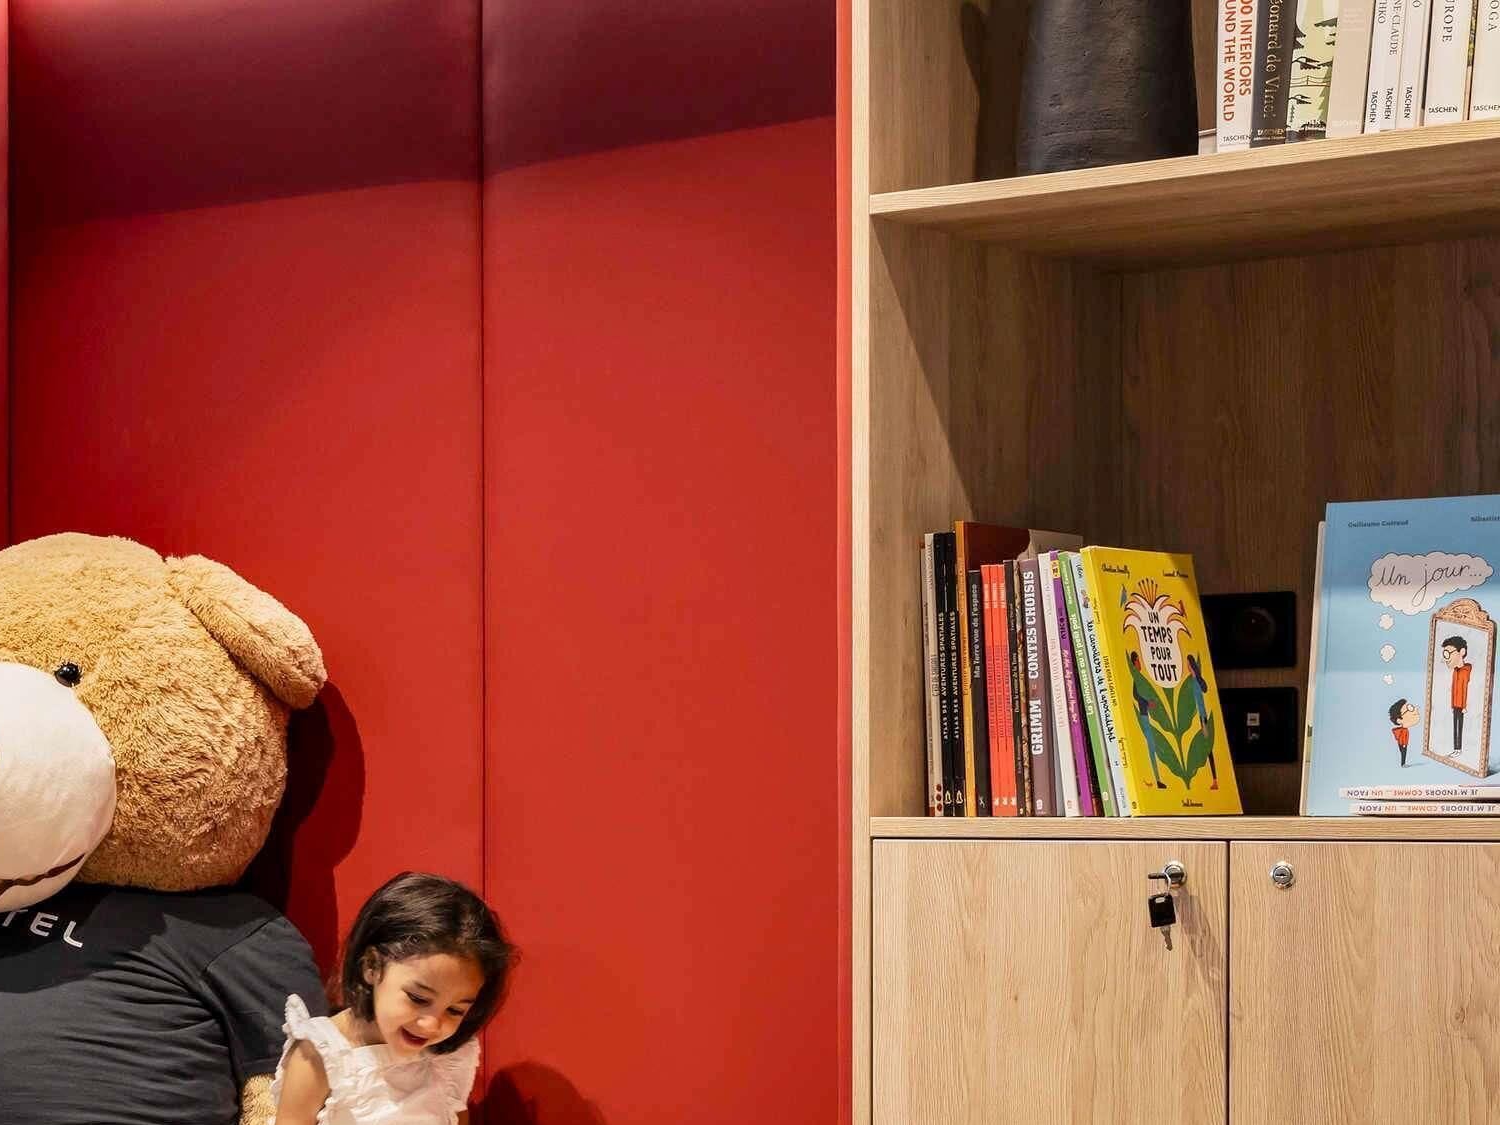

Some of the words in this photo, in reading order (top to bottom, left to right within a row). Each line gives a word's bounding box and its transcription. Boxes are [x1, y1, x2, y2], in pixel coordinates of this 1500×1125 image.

[1224, 37, 1236, 64] THE
[1239, 20, 1253, 96] INTERIORS
[1266, 54, 1281, 72] de
[1223, 67, 1236, 121] WORLD
[1369, 90, 1379, 123] TASCHEN
[1384, 87, 1394, 120] TASCHEN
[1403, 86, 1413, 119] TASCHEN
[1223, 134, 1251, 142] TASCHEN
[1375, 565, 1411, 587] Un
[1023, 571, 1037, 625] CHOISIS
[937, 612, 946, 652] SPATIALES
[950, 611, 958, 650] SPATIALES
[1148, 611, 1160, 624] UN
[1141, 625, 1173, 644] TEMPS
[1026, 628, 1040, 680] CONTES
[1150, 646, 1172, 661] POUR
[939, 652, 948, 697] AVENTURES
[951, 652, 959, 695] AVENTURES
[1151, 663, 1178, 682] TOUT
[1029, 699, 1044, 756] GRIMM
